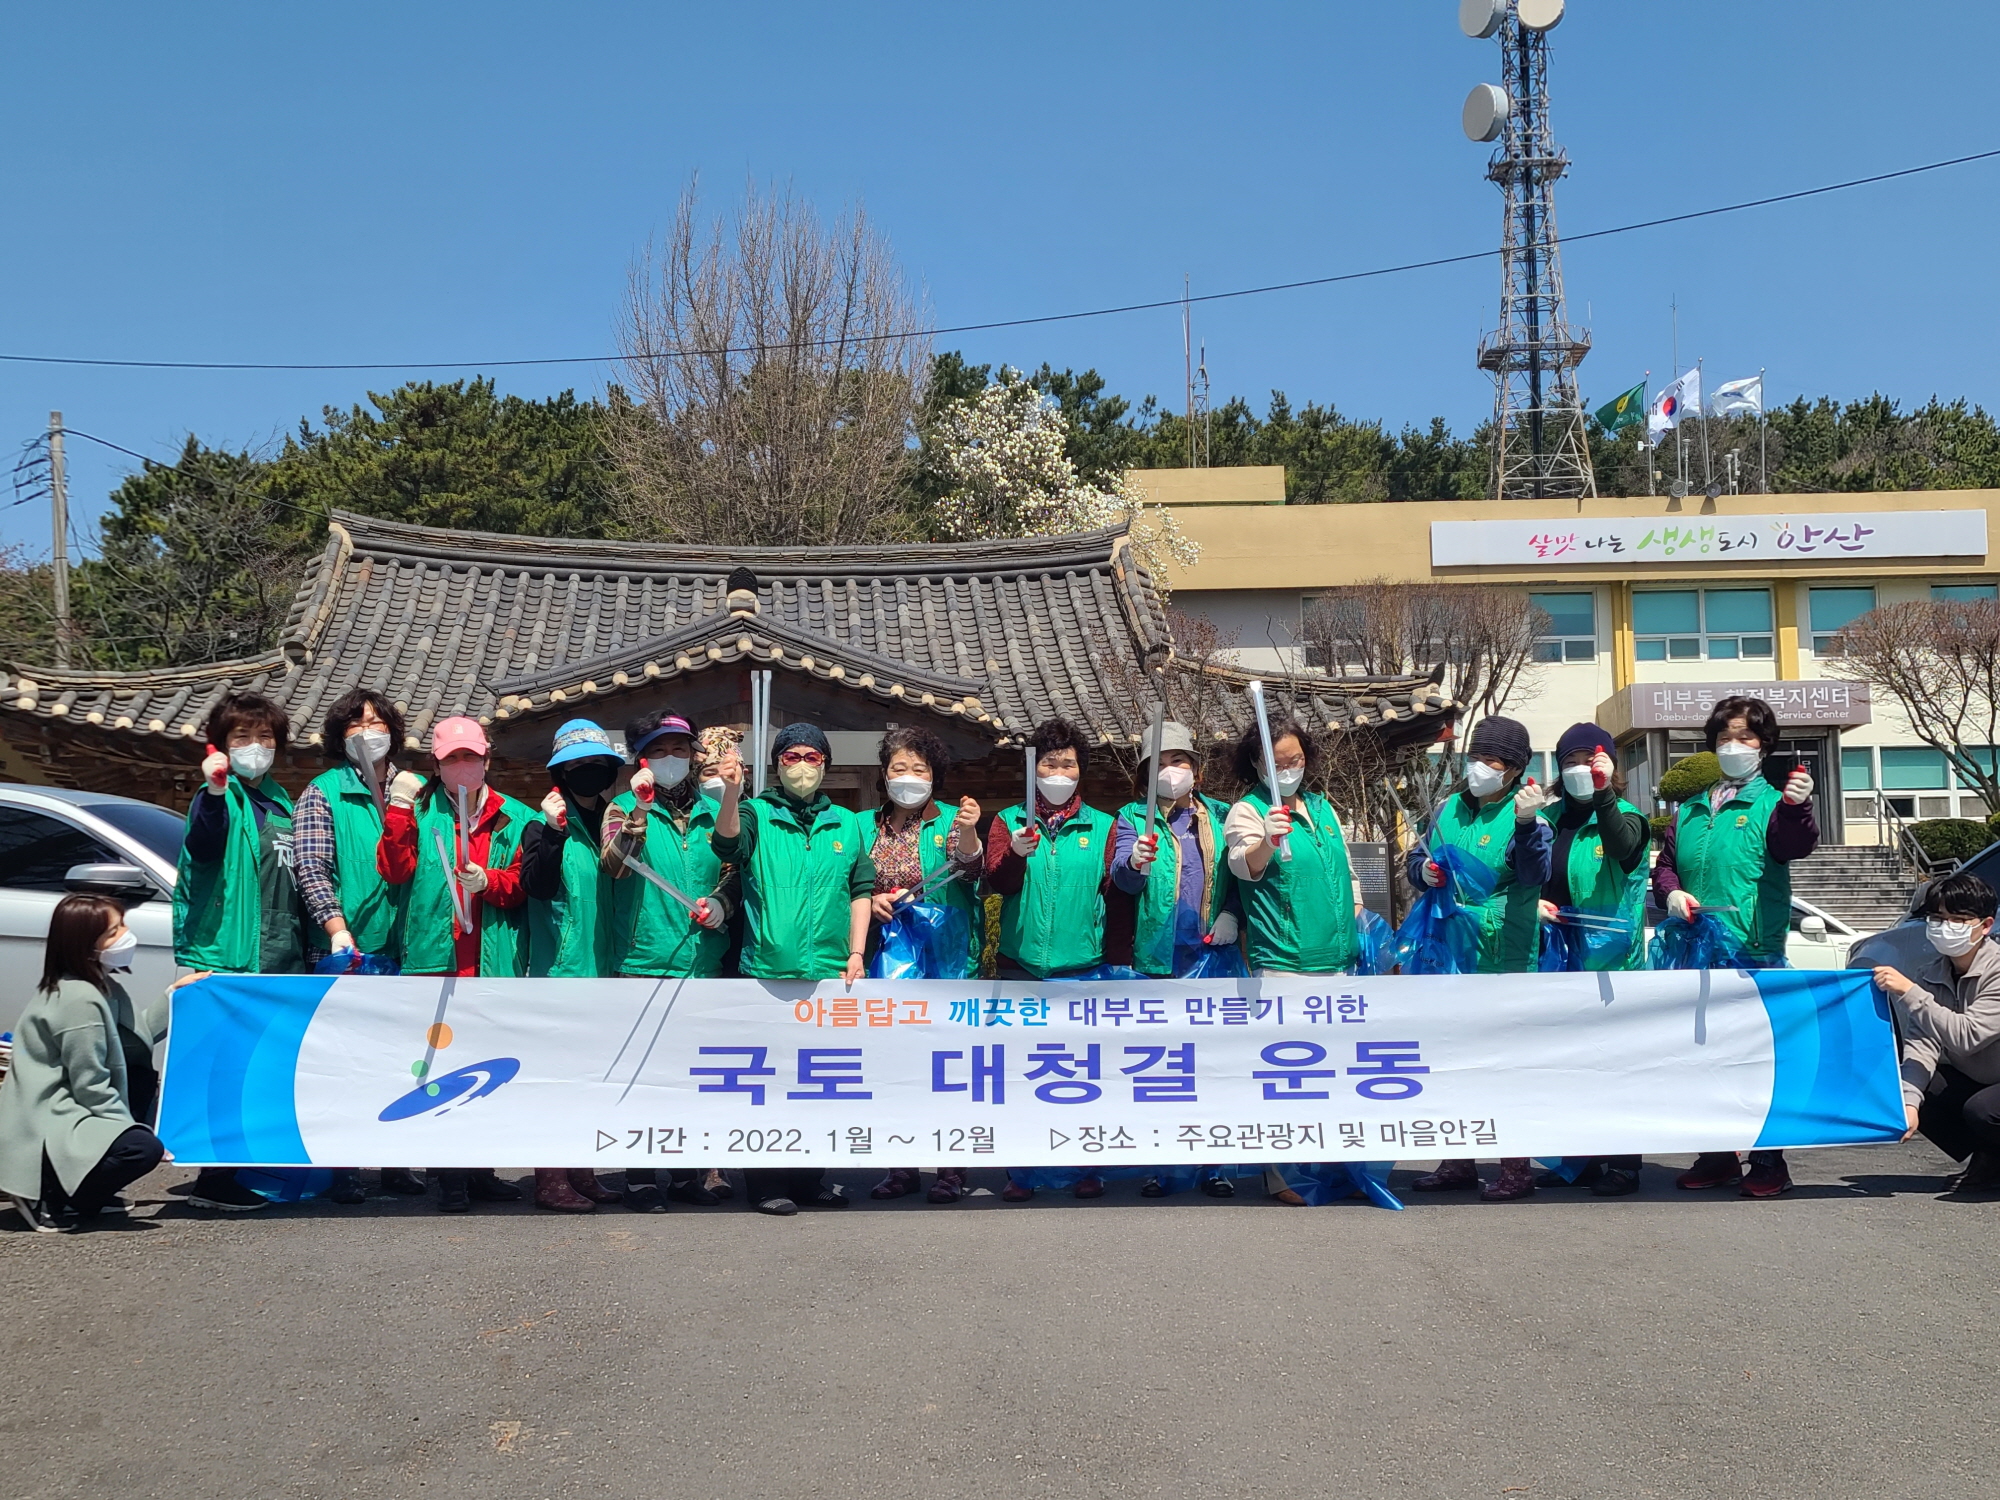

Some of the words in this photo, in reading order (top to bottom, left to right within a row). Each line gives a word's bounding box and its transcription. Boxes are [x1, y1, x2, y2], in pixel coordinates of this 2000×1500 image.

[1653, 689, 1716, 712] 대부동
[1777, 710, 1812, 719] Service
[1815, 708, 1850, 719] Center
[793, 997, 932, 1029] 아름답고
[948, 997, 1050, 1028] 깨끗한
[1068, 997, 1169, 1027] 대부도
[1185, 996, 1285, 1026] 만들기
[1302, 995, 1369, 1025] 위한
[689, 1046, 873, 1106] 국토
[931, 1041, 1198, 1105] 대청결
[1251, 1040, 1431, 1101] 운동
[625, 1126, 688, 1155] 기간
[727, 1129, 811, 1155] 2022.
[826, 1126, 873, 1155] 1월
[931, 1126, 995, 1155] 12월
[1078, 1125, 1137, 1153] 장소
[1176, 1121, 1325, 1152] 주요관광지
[1338, 1120, 1367, 1149] 및
[1380, 1118, 1498, 1148] 마을안길
